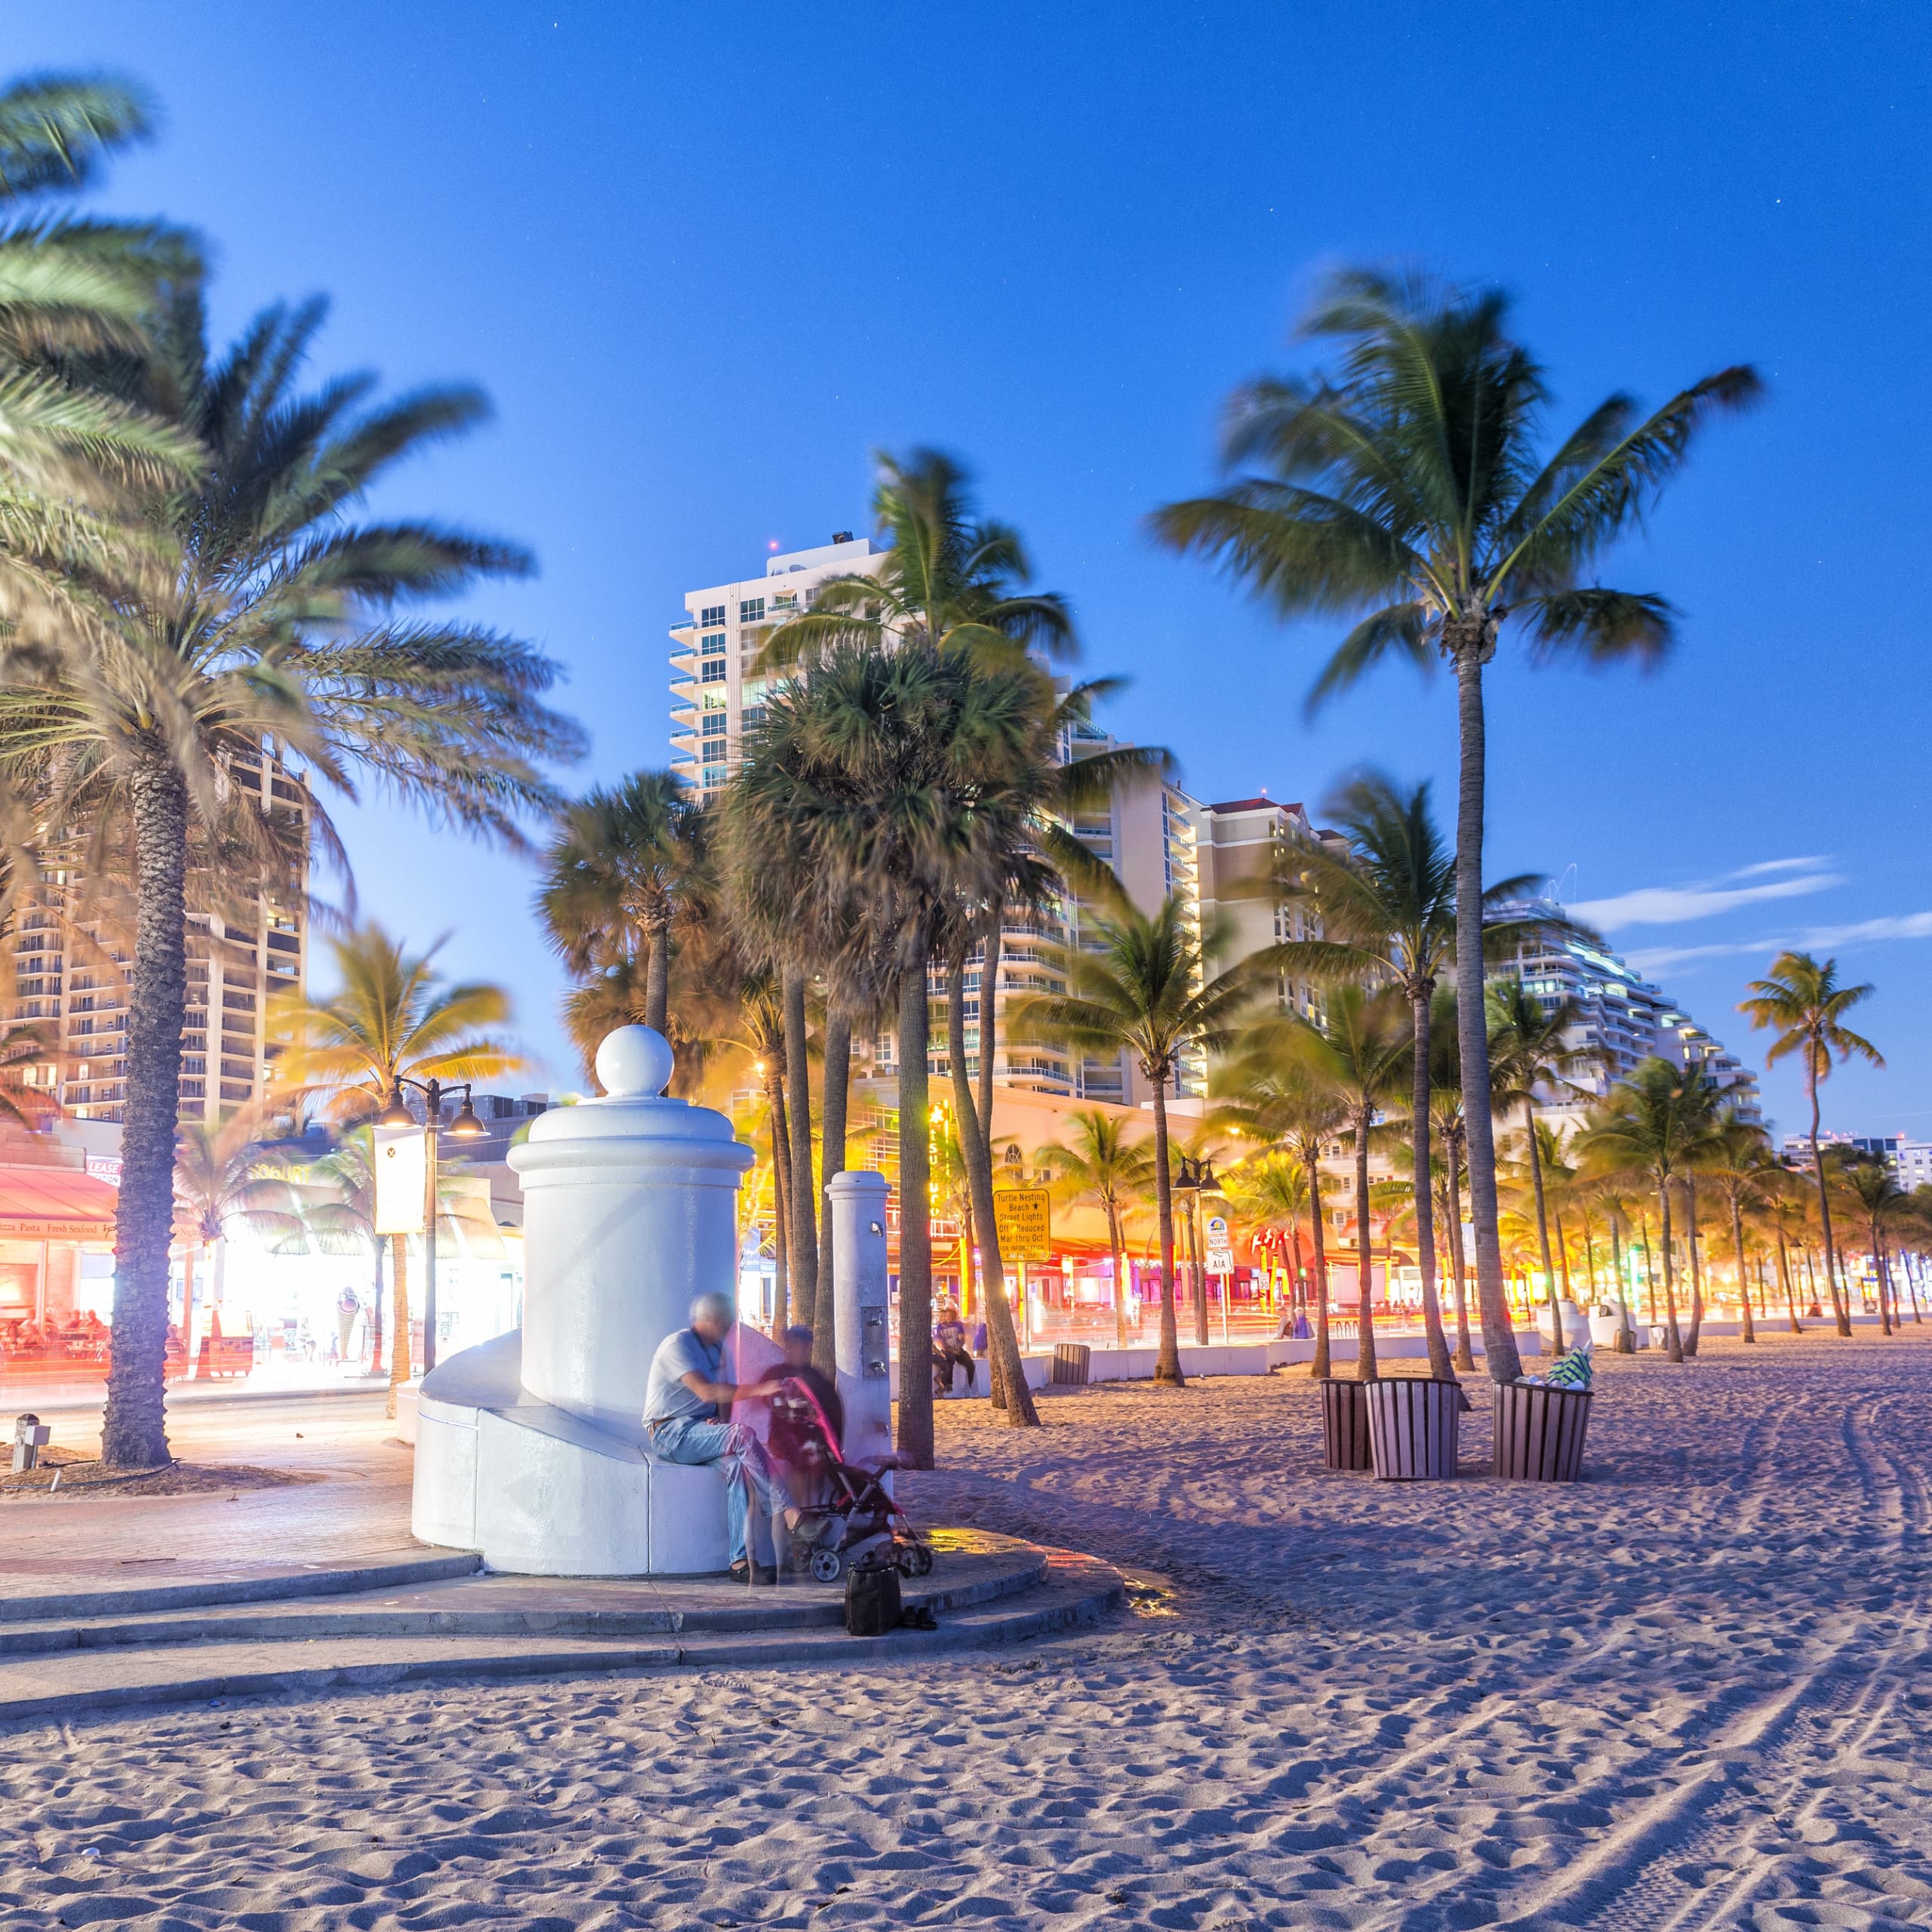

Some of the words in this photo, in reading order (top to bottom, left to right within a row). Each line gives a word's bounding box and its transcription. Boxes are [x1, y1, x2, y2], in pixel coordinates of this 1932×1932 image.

[88, 1162, 118, 1174] LEASE
[997, 1194, 1017, 1202] Turtle
[1020, 1193, 1045, 1203] Nesting
[1009, 1204, 1029, 1212] Beach
[1022, 1213, 1044, 1222] Lights
[20, 1223, 40, 1232] Pasta
[47, 1224, 67, 1232] Fresh
[69, 1225, 97, 1233] Seafood
[998, 1224, 1008, 1232] Off
[1016, 1224, 1044, 1232] Reduced
[1001, 1235, 1012, 1243] Mar
[1214, 1260, 1226, 1269] A1A
